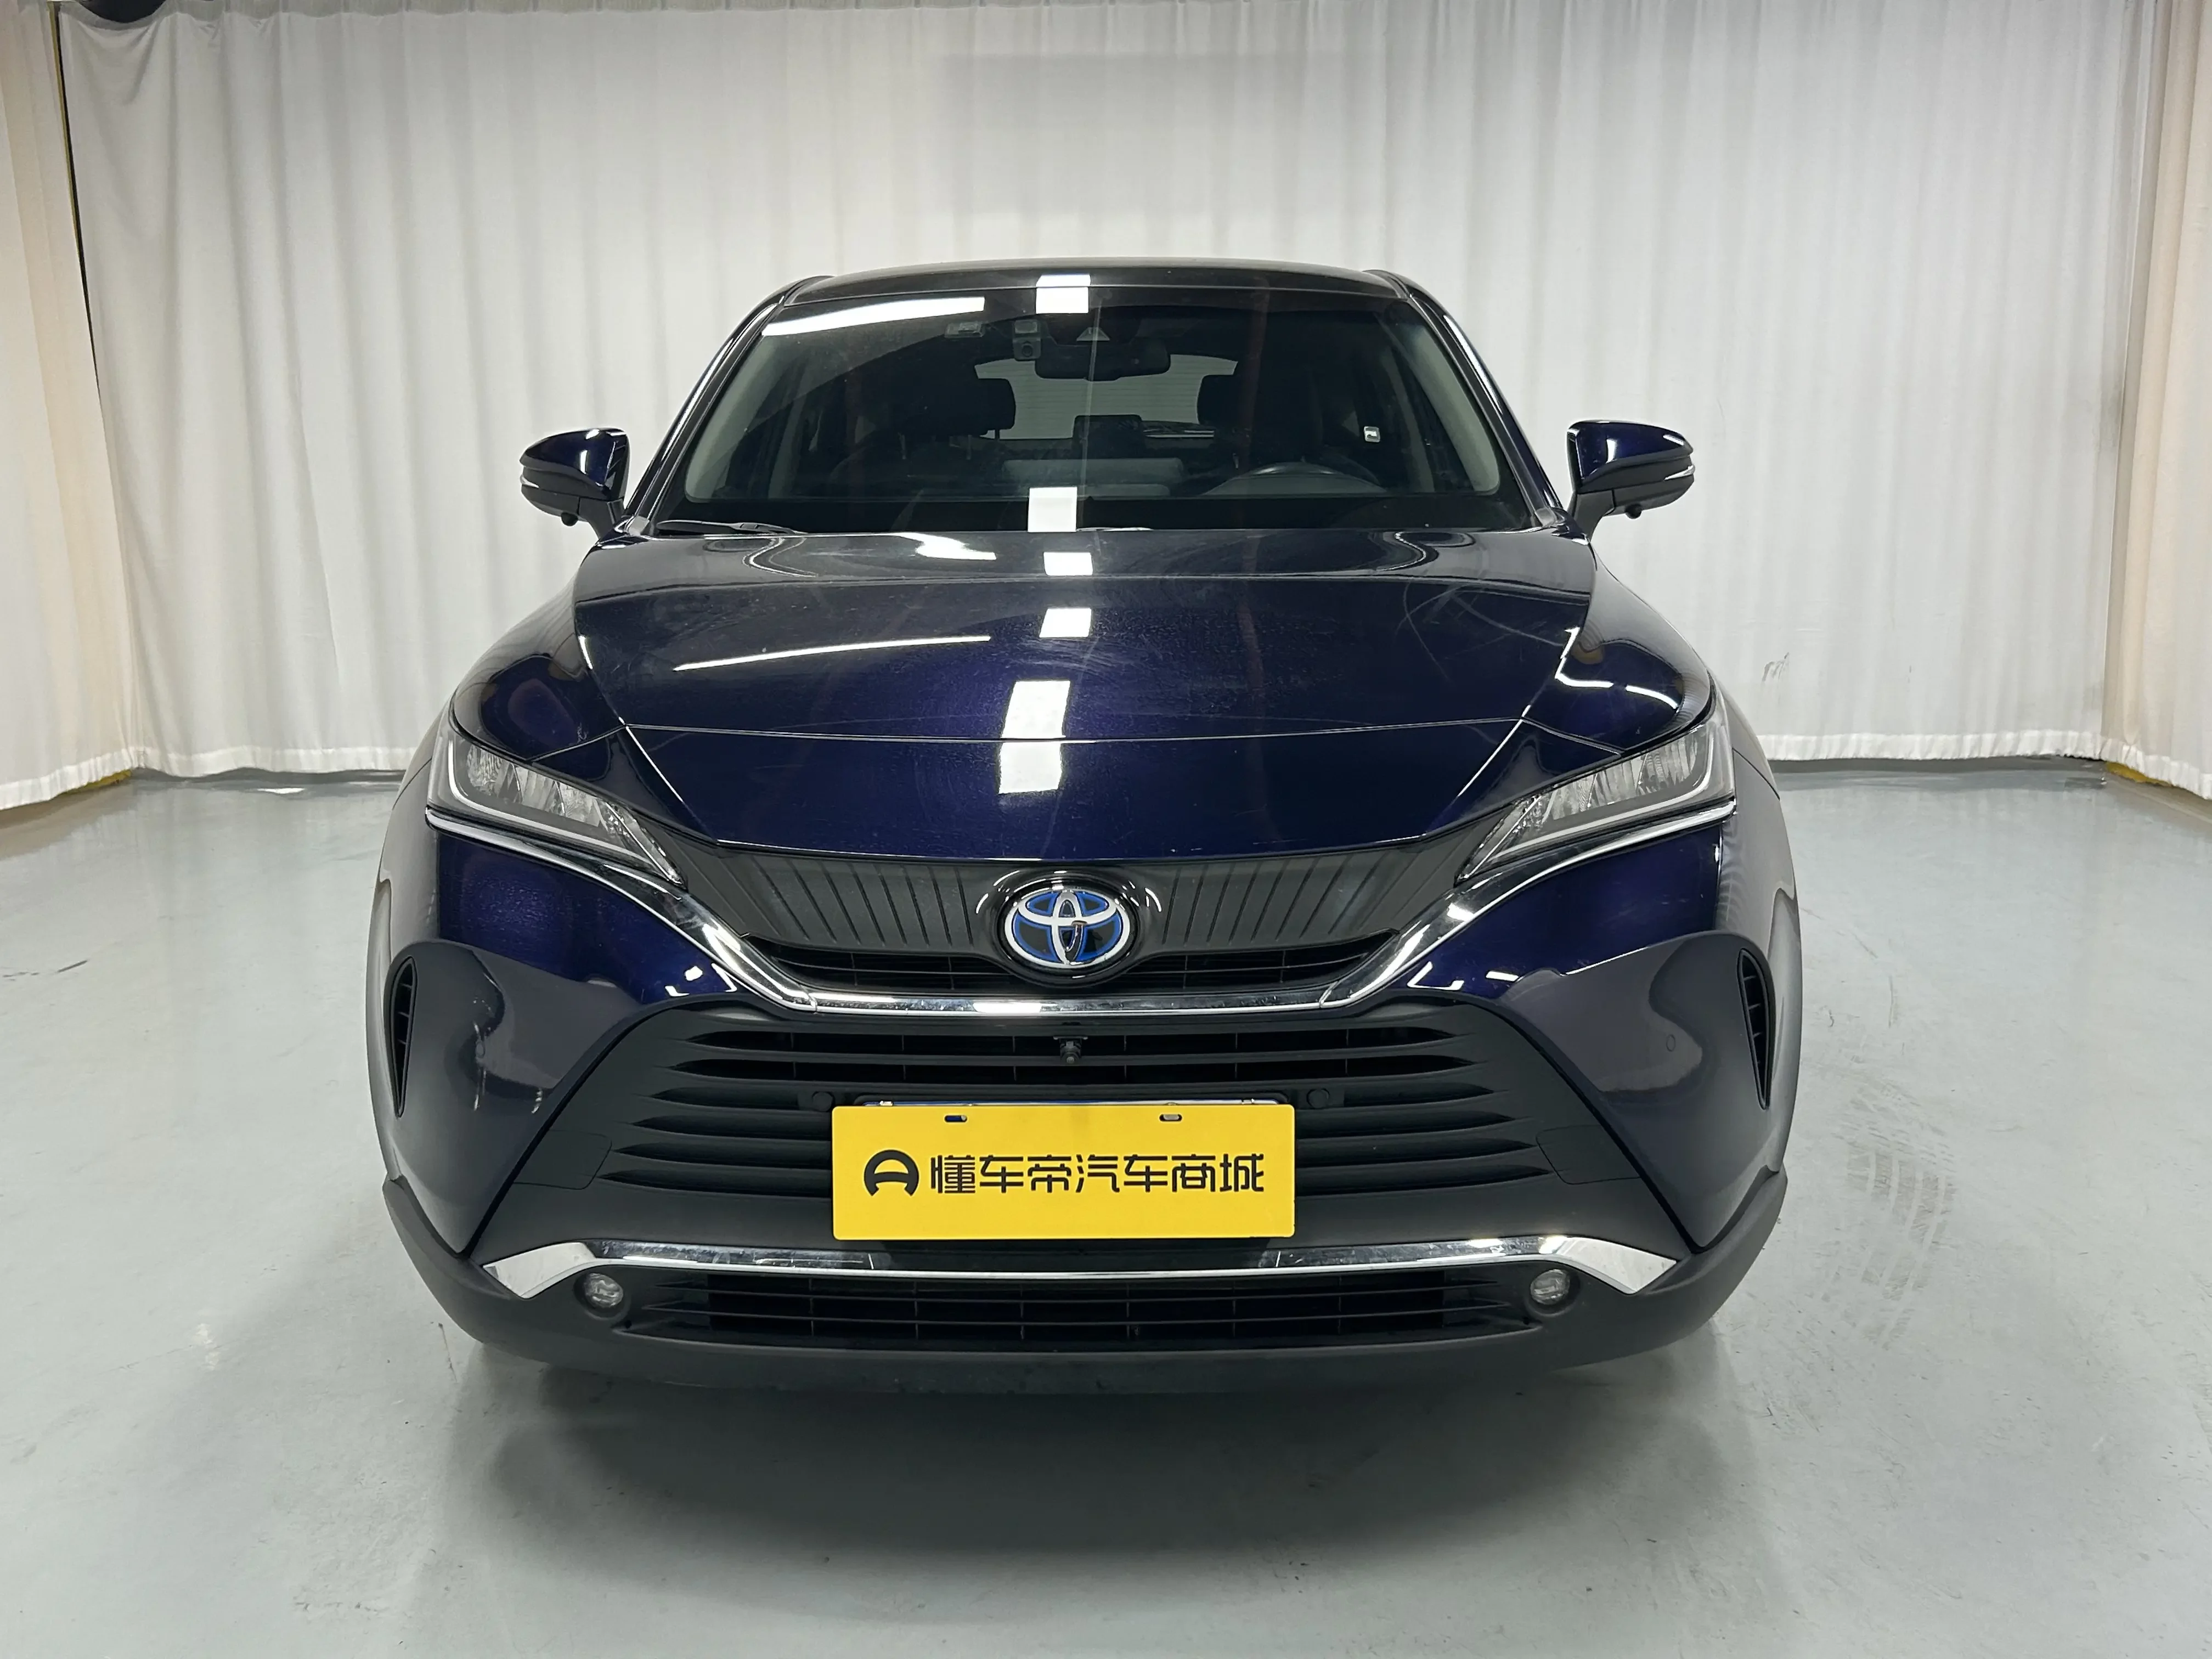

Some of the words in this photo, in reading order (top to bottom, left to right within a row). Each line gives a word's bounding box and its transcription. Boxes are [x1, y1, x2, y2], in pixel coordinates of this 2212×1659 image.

[930, 1153, 1264, 1194] 懂车帝汽车商城
